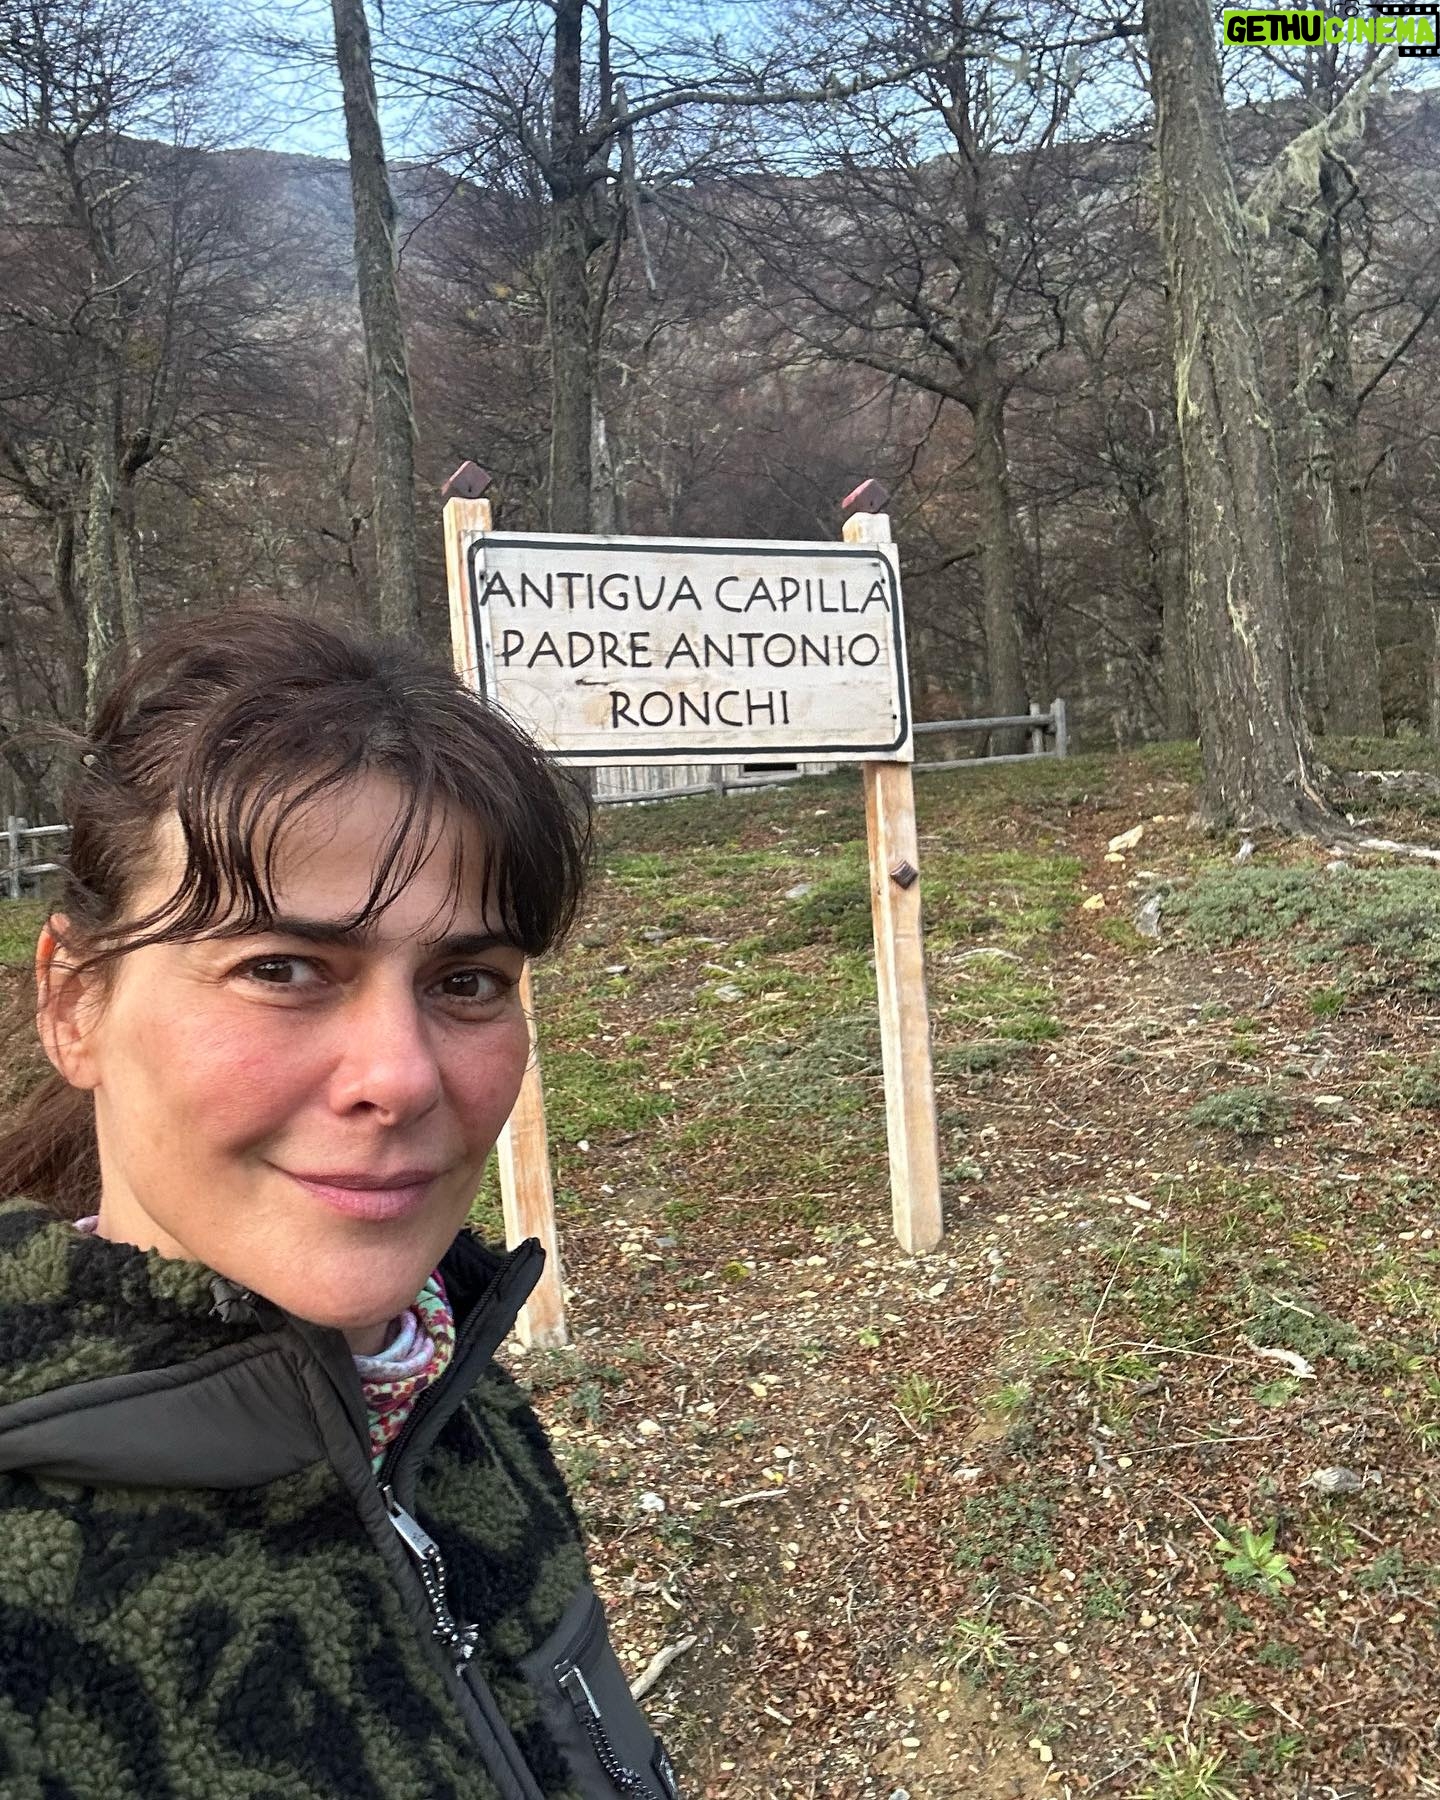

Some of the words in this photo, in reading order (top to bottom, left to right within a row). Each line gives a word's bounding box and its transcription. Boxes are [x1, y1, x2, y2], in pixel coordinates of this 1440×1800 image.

[480, 571, 701, 611] ANTIGUA
[715, 575, 890, 613] CAPILLA
[502, 629, 652, 668] PADRE
[665, 631, 881, 668] ANTONIO
[610, 688, 789, 728] RONCHI
